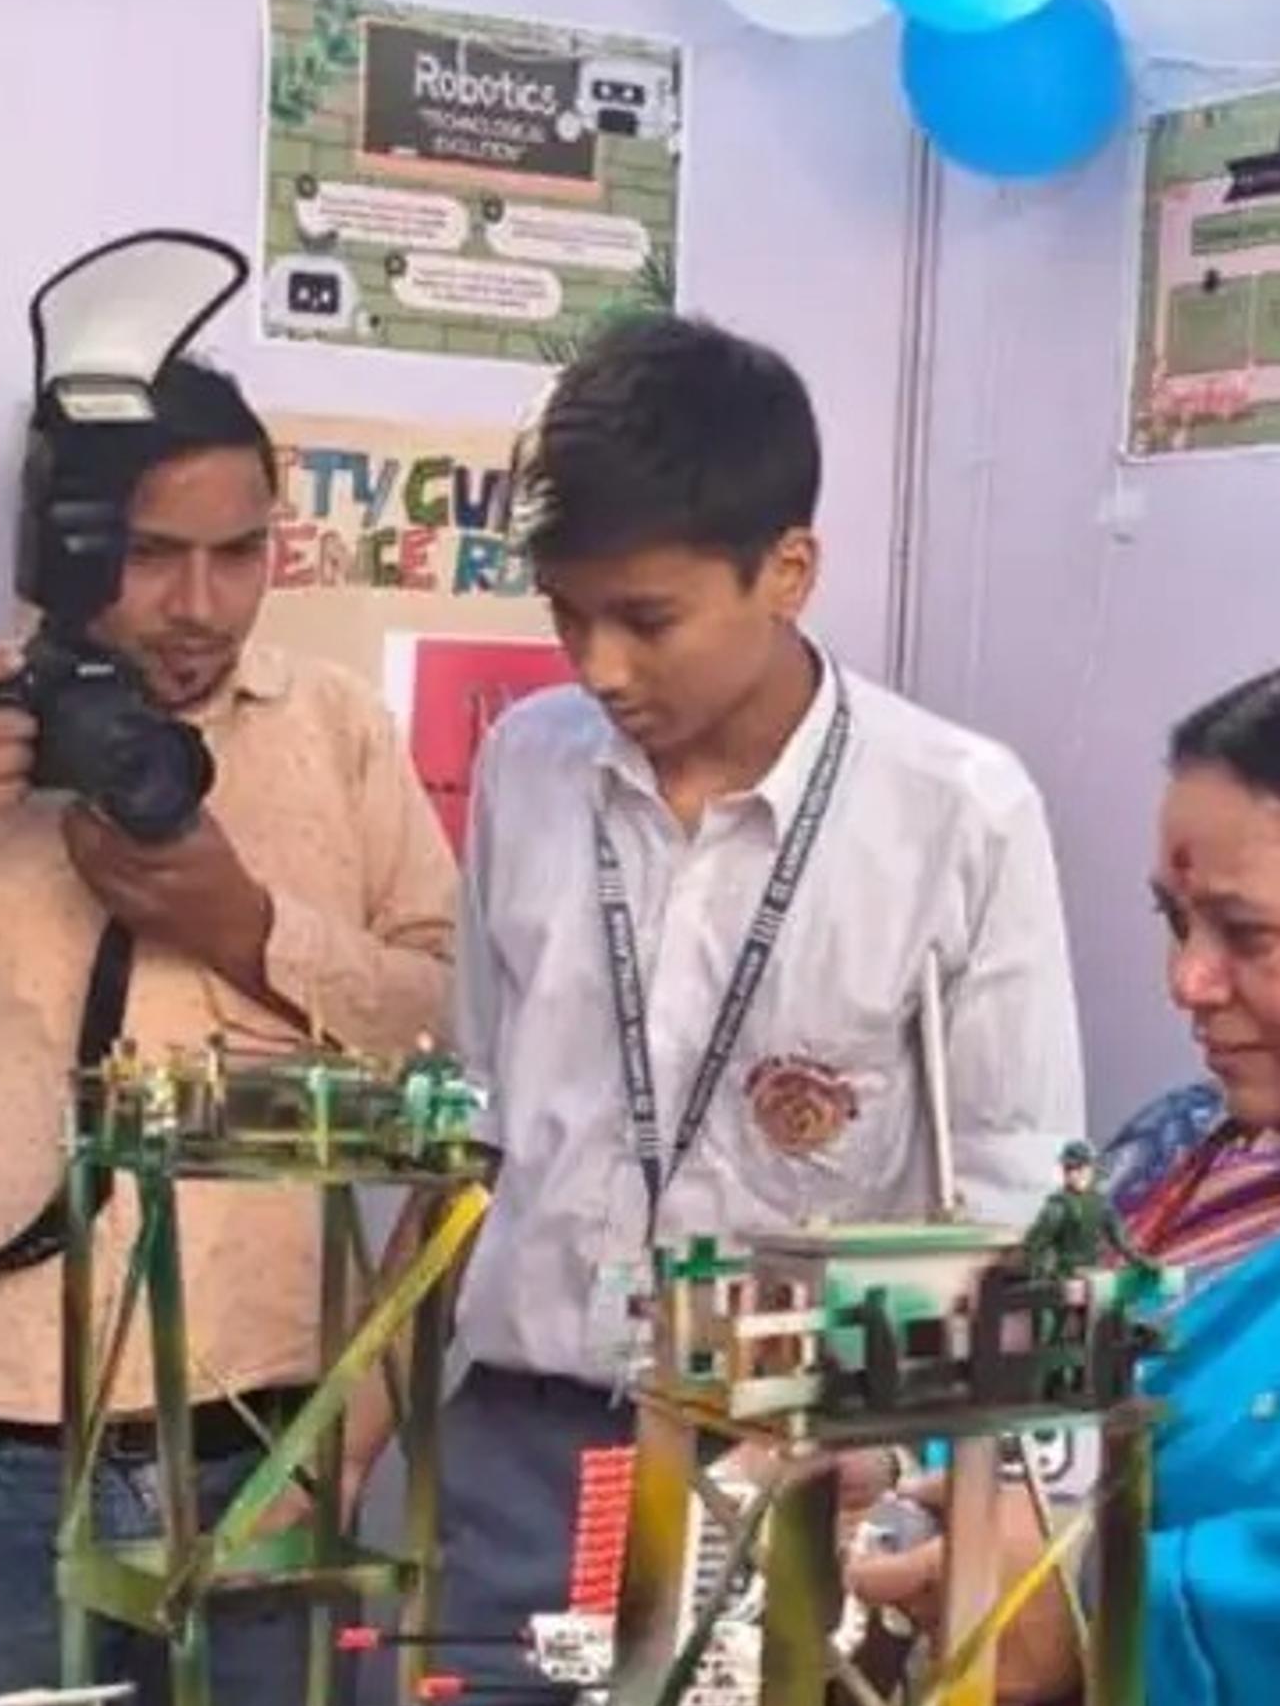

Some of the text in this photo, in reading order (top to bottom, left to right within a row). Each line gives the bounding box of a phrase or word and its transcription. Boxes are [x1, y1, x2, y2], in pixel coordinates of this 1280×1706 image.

[415, 50, 557, 116] Robotics
[271, 445, 401, 527] ITY
[271, 523, 440, 590] ENCE
